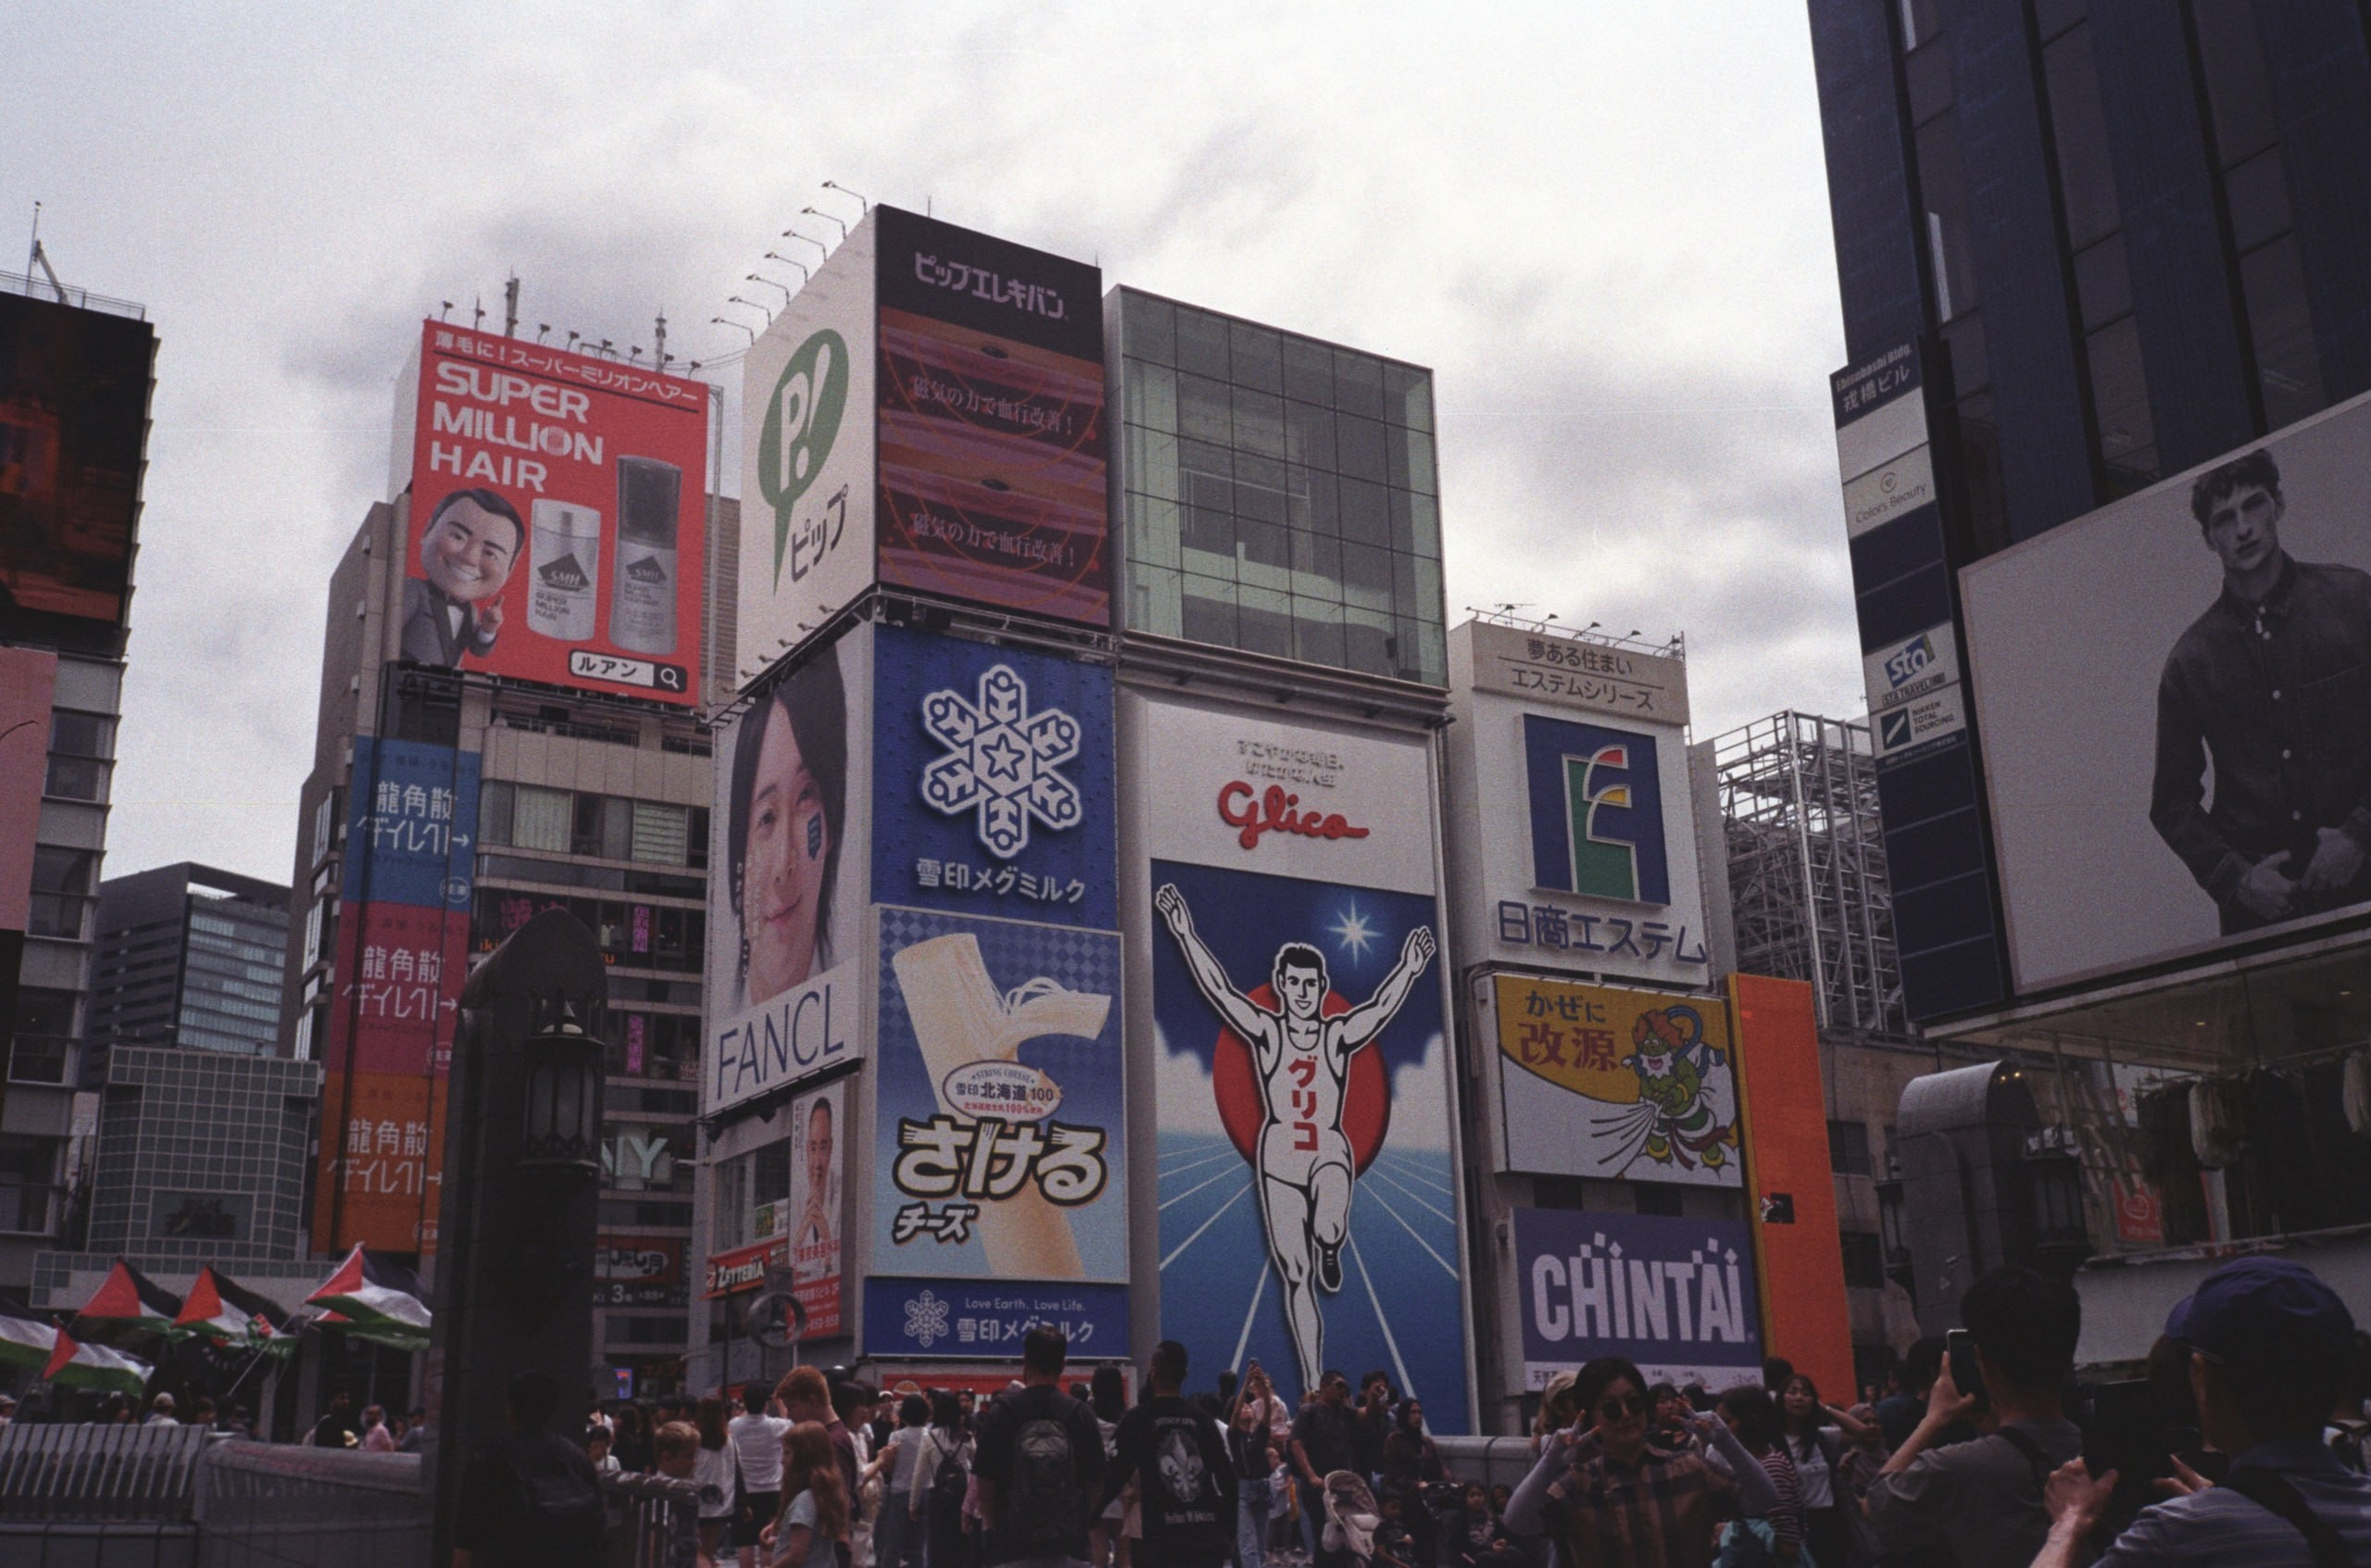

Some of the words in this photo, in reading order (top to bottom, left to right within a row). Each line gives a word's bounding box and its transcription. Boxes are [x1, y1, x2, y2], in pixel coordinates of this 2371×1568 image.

[915, 252, 1064, 320] ピップエレキバン
[436, 360, 590, 423] SUPER
[433, 401, 603, 465] MILLION
[431, 442, 547, 492] HAIR
[791, 483, 849, 583] ピップ
[579, 658, 637, 678] ルアン
[1527, 639, 1633, 677] 夢ある住まい
[1890, 649, 1927, 682] sta
[1512, 669, 1654, 711] エステムシリーズ
[1219, 780, 1371, 849] Glico
[916, 858, 1086, 904] 雪印メグミルク
[1499, 901, 1709, 964] 日商エステム
[1525, 990, 1607, 1023] かぜに
[717, 985, 845, 1101] FANCL
[1518, 1022, 1618, 1073] 改源
[1287, 1056, 1319, 1152] グリコ
[895, 1117, 1106, 1203] さける
[895, 1204, 978, 1242] チーズ
[965, 1298, 991, 1310] Love
[994, 1298, 1030, 1310] Earth.
[1034, 1299, 1060, 1311] Love
[1062, 1299, 1086, 1311] Life.
